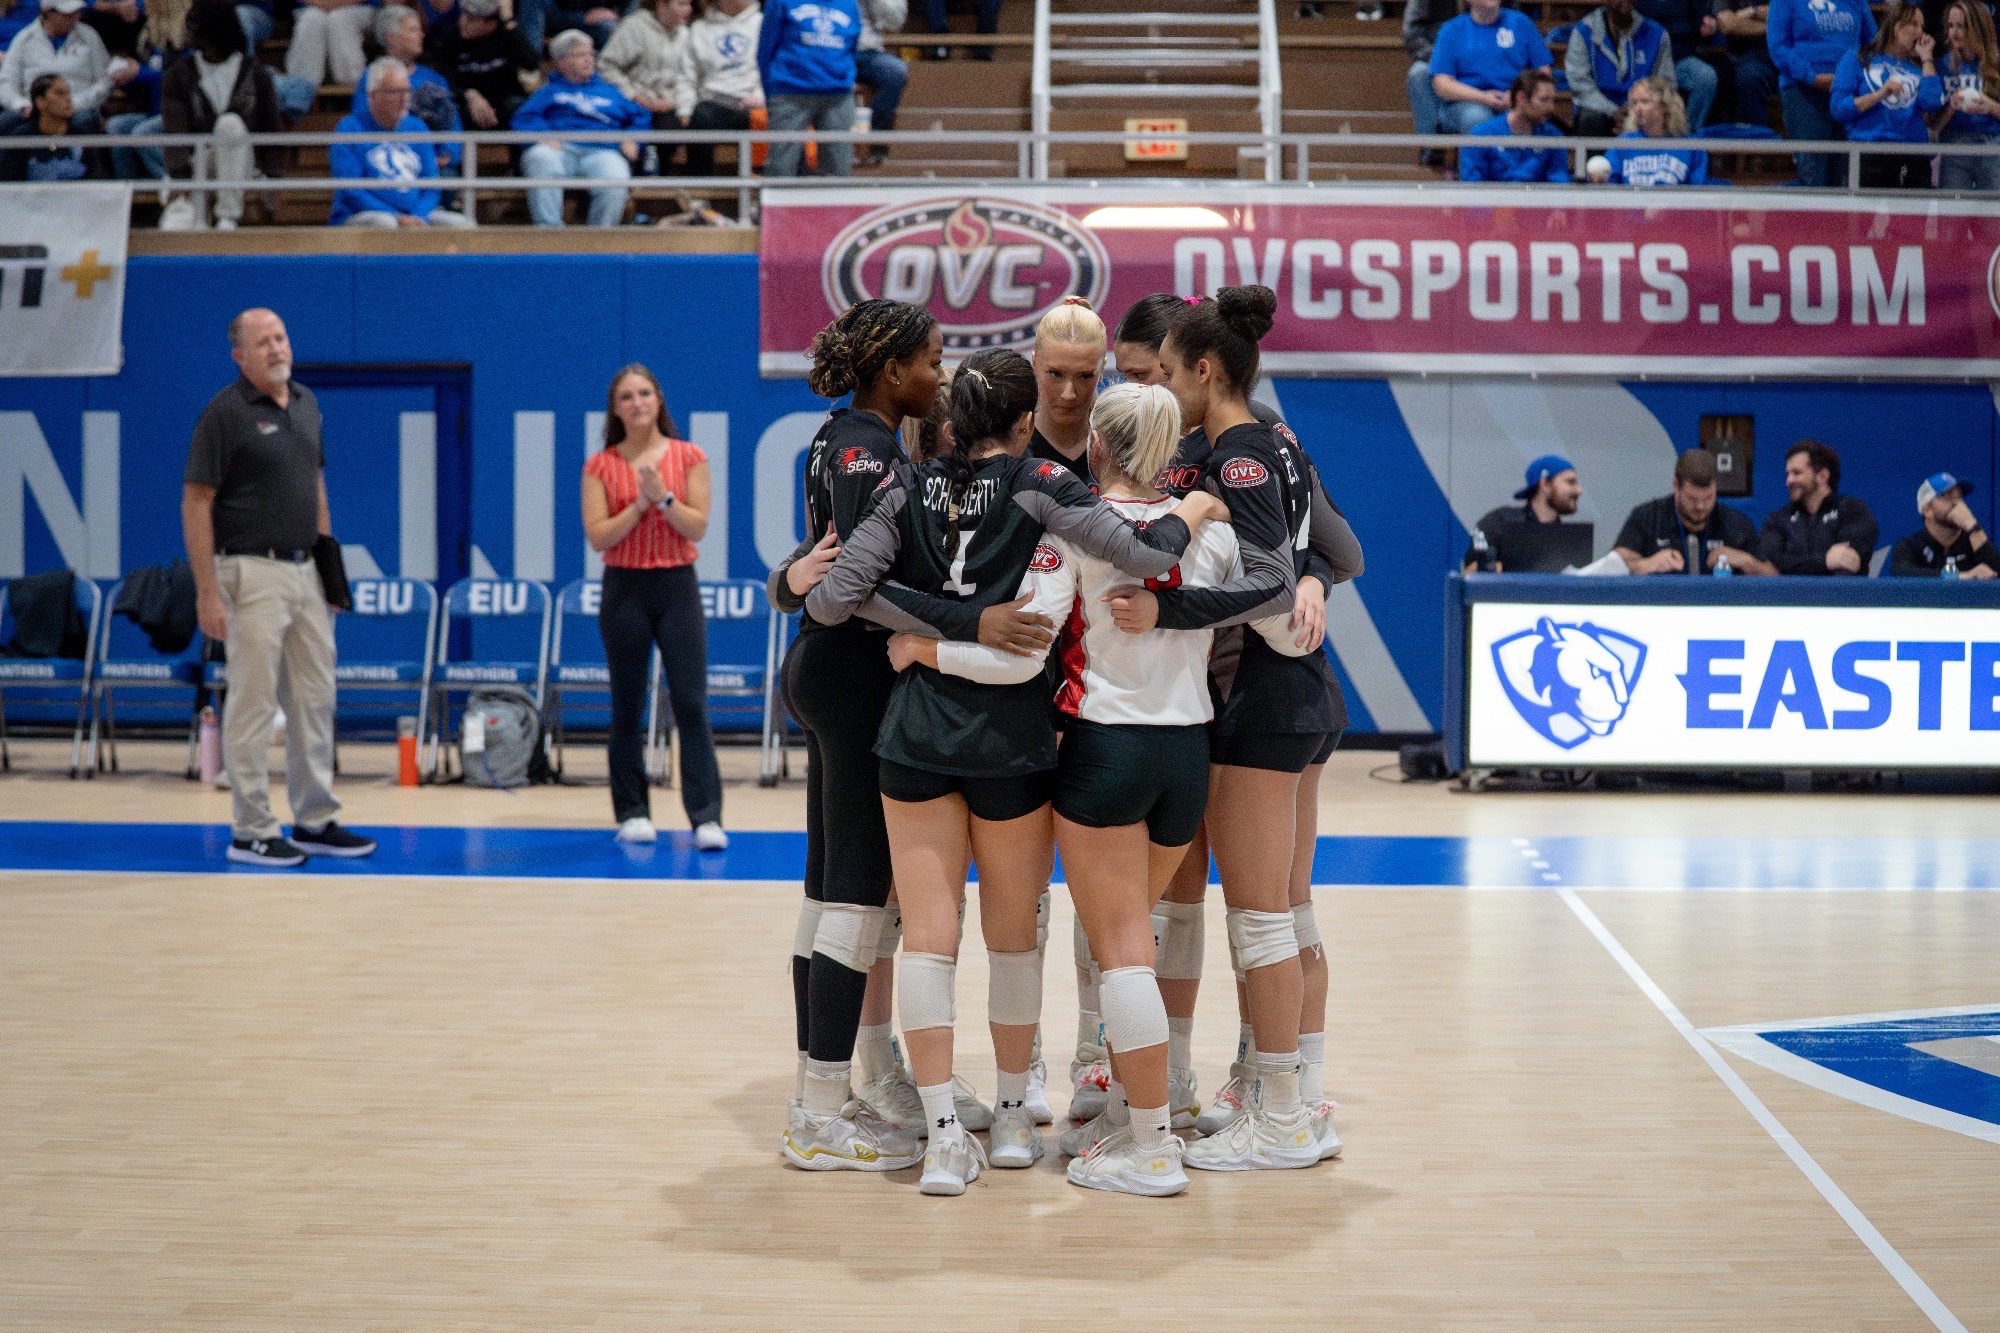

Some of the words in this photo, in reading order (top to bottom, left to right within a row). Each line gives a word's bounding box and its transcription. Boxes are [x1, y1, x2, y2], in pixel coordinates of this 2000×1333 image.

[883, 245, 1044, 311] OVC
[1174, 237, 1926, 326] OVCSPORTS.COM
[847, 460, 884, 473] SEMO
[1155, 467, 1201, 489] EMO
[1229, 466, 1258, 480] OVC
[923, 477, 1000, 516] SCHBERTH
[355, 581, 414, 615] EIU
[469, 582, 528, 615] EIU
[700, 586, 754, 618] EIU
[101, 663, 171, 678] PANTHERS
[335, 666, 398, 680] ANTHERS
[446, 667, 518, 681] PANTHERS
